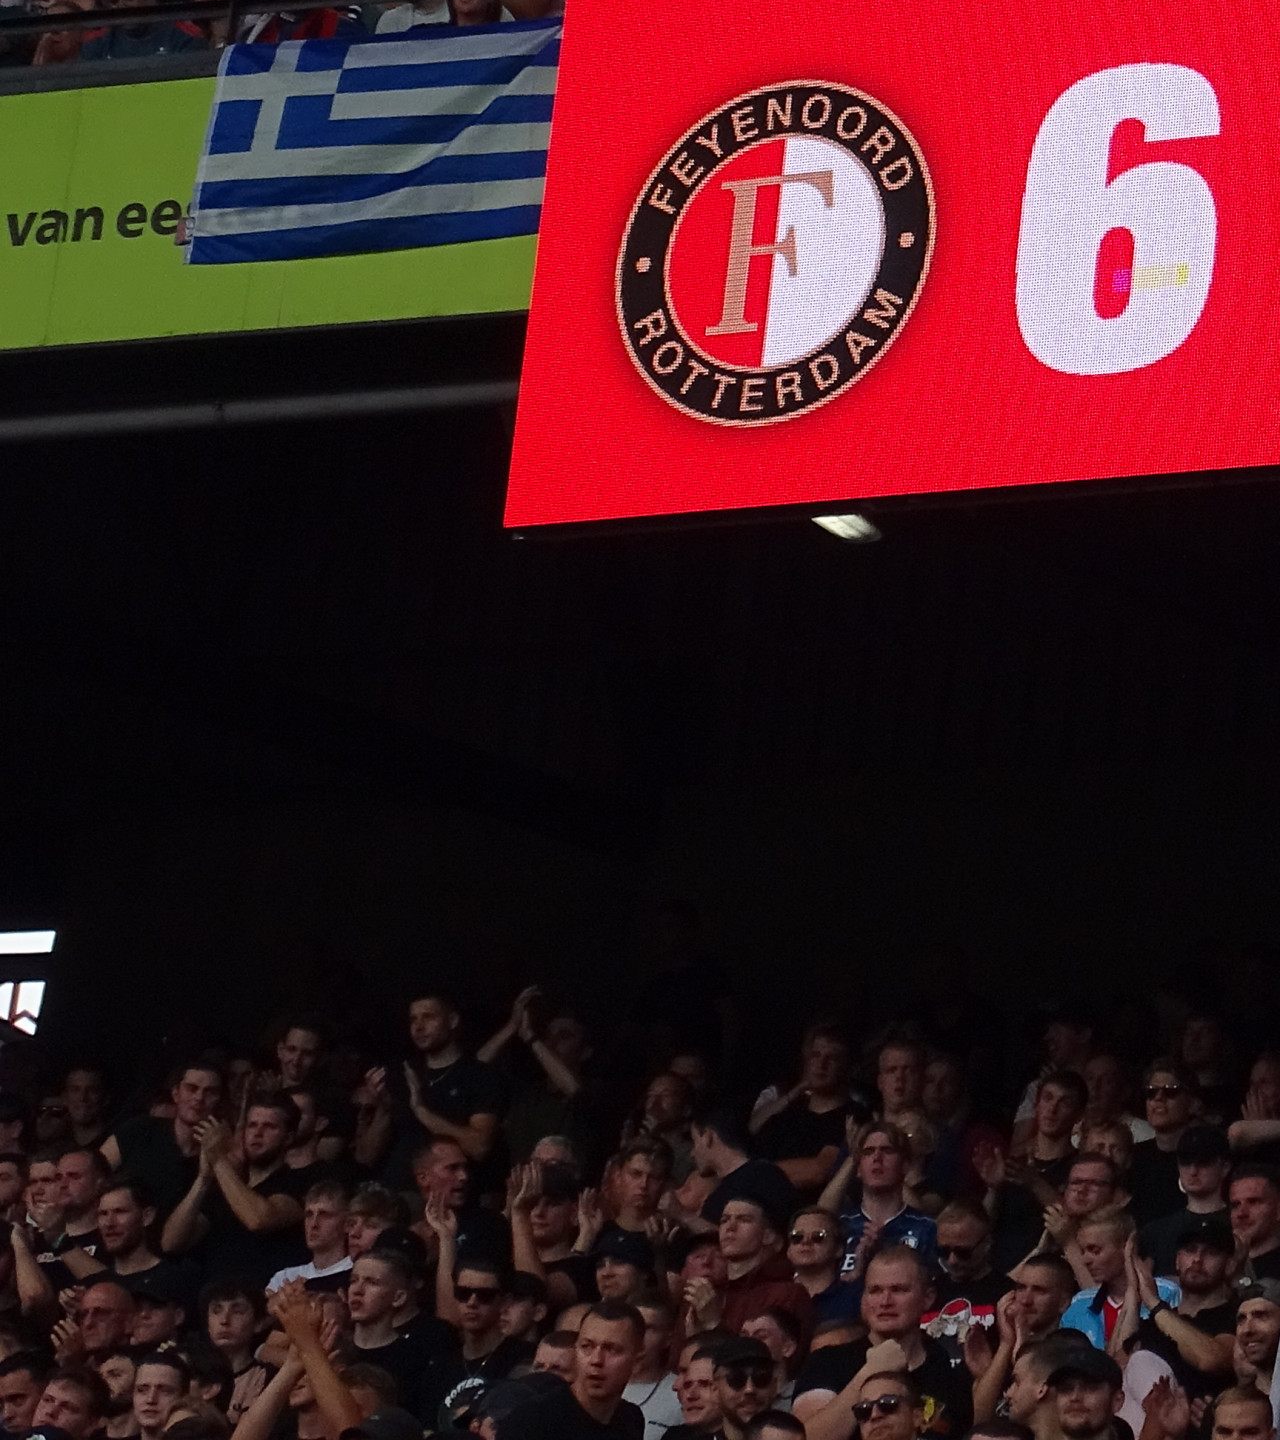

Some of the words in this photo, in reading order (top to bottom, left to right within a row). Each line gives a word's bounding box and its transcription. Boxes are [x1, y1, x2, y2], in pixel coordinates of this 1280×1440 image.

[647, 92, 915, 216] FEYENOORD
[7, 204, 104, 248] van
[116, 198, 193, 241] ee
[704, 169, 835, 337] F
[1015, 62, 1221, 376] 6
[634, 286, 906, 414] ROTTERDAM
